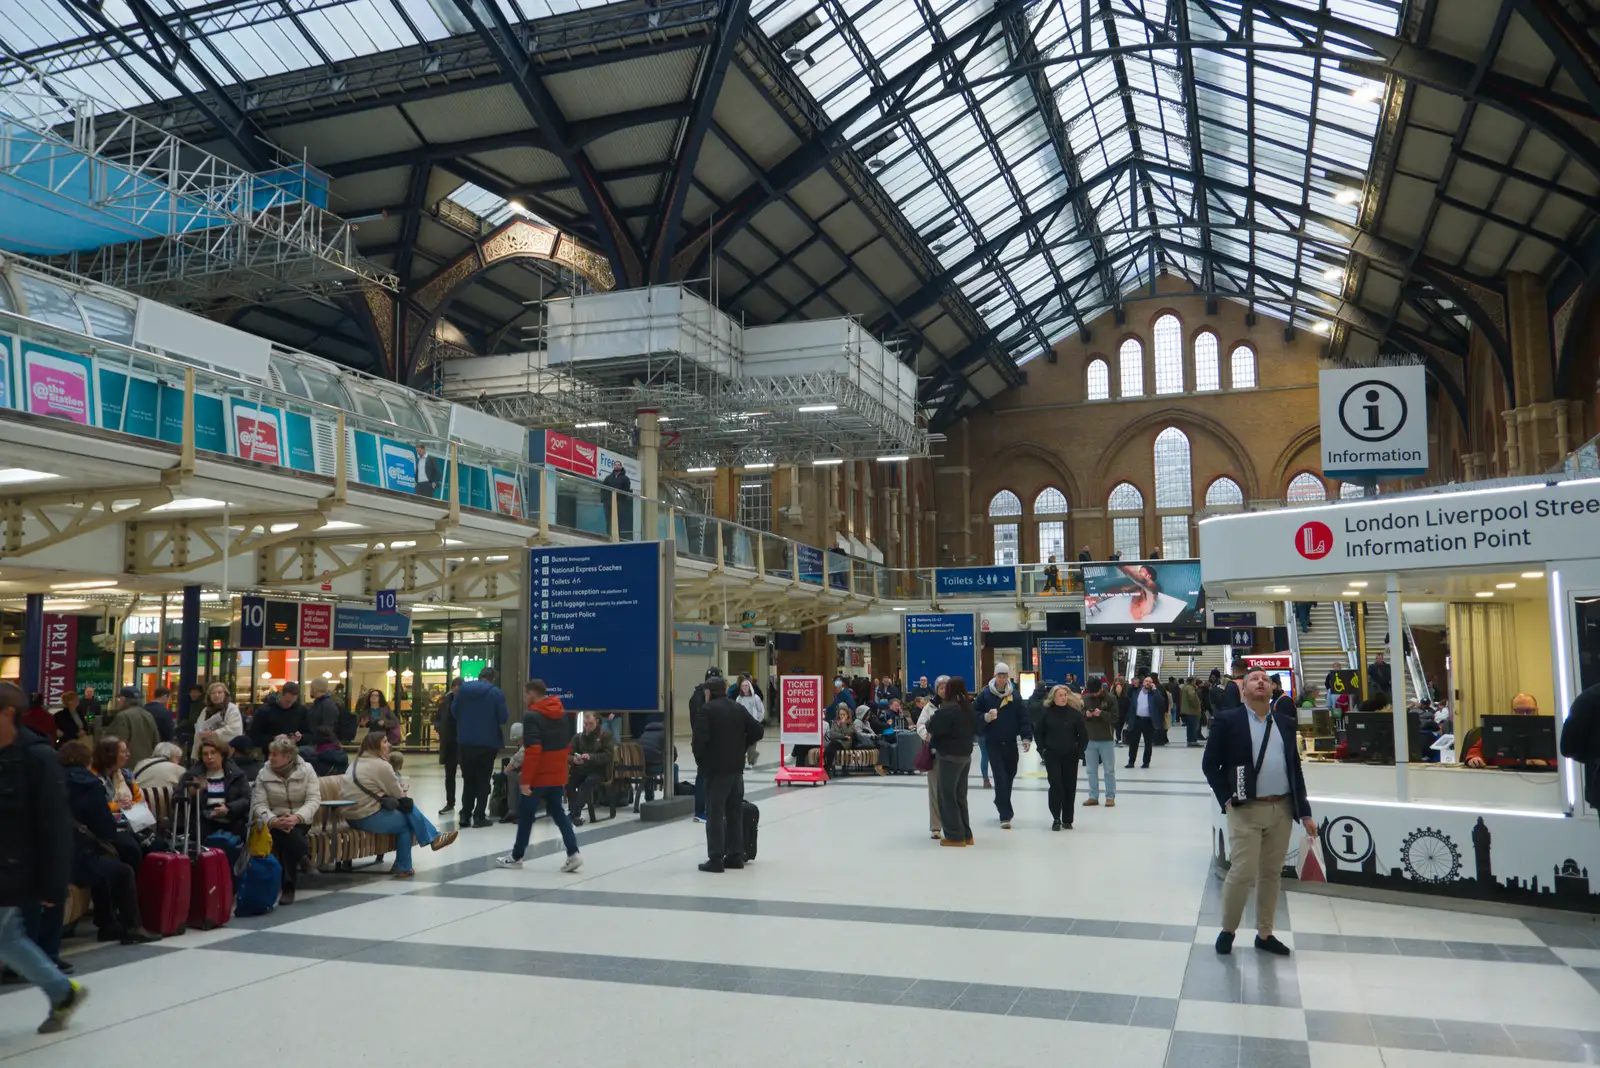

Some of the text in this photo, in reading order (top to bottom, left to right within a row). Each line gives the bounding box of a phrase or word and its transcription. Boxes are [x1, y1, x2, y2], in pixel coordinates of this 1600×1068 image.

[49, 393, 84, 407] Station
[1327, 448, 1422, 464] Information
[1345, 513, 1419, 533] London
[1426, 501, 1527, 527] Liverpool
[1346, 528, 1531, 557] Information Point
[942, 576, 973, 586] Toilets
[378, 594, 395, 609] 10
[243, 604, 264, 627] 10
[338, 621, 358, 629] London
[51, 624, 68, 656] PRET
[50, 661, 65, 671] A
[77, 658, 100, 669] sushi
[1249, 659, 1275, 667] Tickets
[787, 680, 814, 689] TICKET
[787, 689, 815, 697] OFFICE
